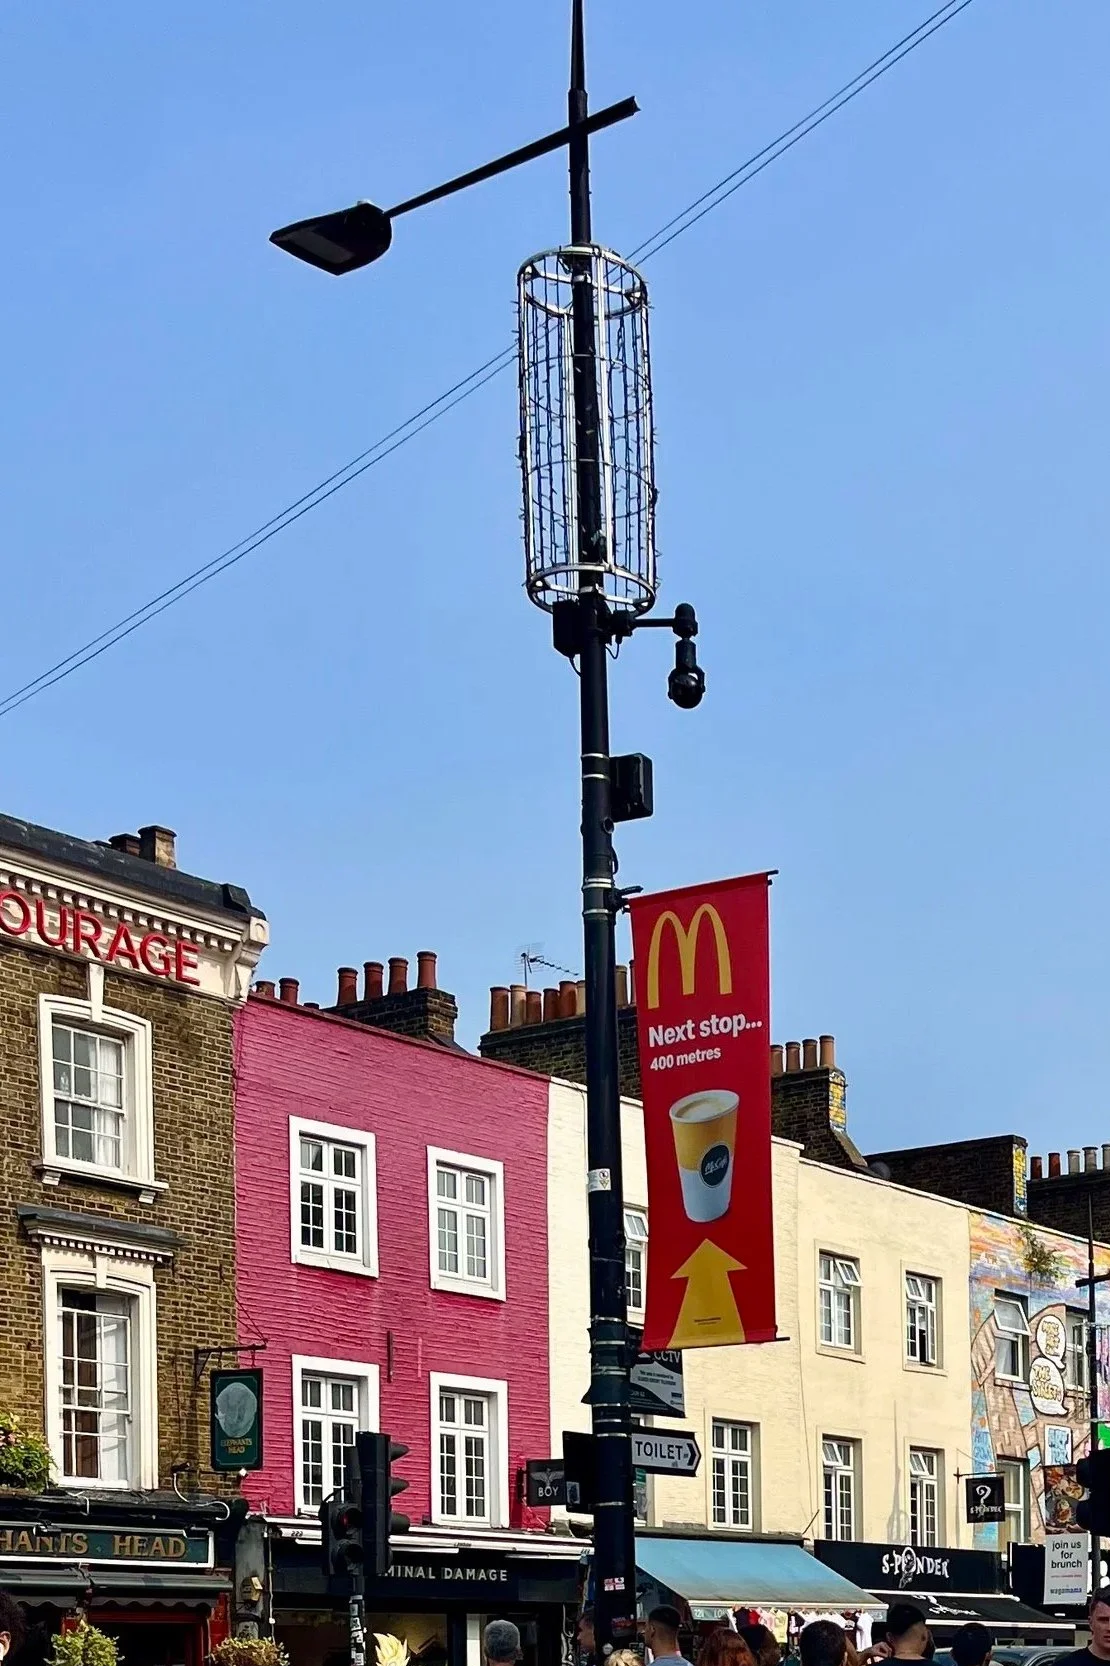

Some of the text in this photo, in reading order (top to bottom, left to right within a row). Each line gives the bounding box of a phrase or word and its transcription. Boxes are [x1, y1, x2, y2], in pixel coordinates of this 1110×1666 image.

[648, 1013, 763, 1047] Next stop...
[650, 1047, 721, 1071] 400 metres
[653, 1350, 681, 1363] CCTV
[635, 1441, 683, 1461] TOILET
[538, 1486, 559, 1497] BOY
[113, 1535, 187, 1558] HEAD
[1052, 1540, 1082, 1551] join us
[1061, 1551, 1073, 1559] for
[1051, 1560, 1082, 1568] brunch
[385, 1565, 508, 1581] MINAL DAMAGE
